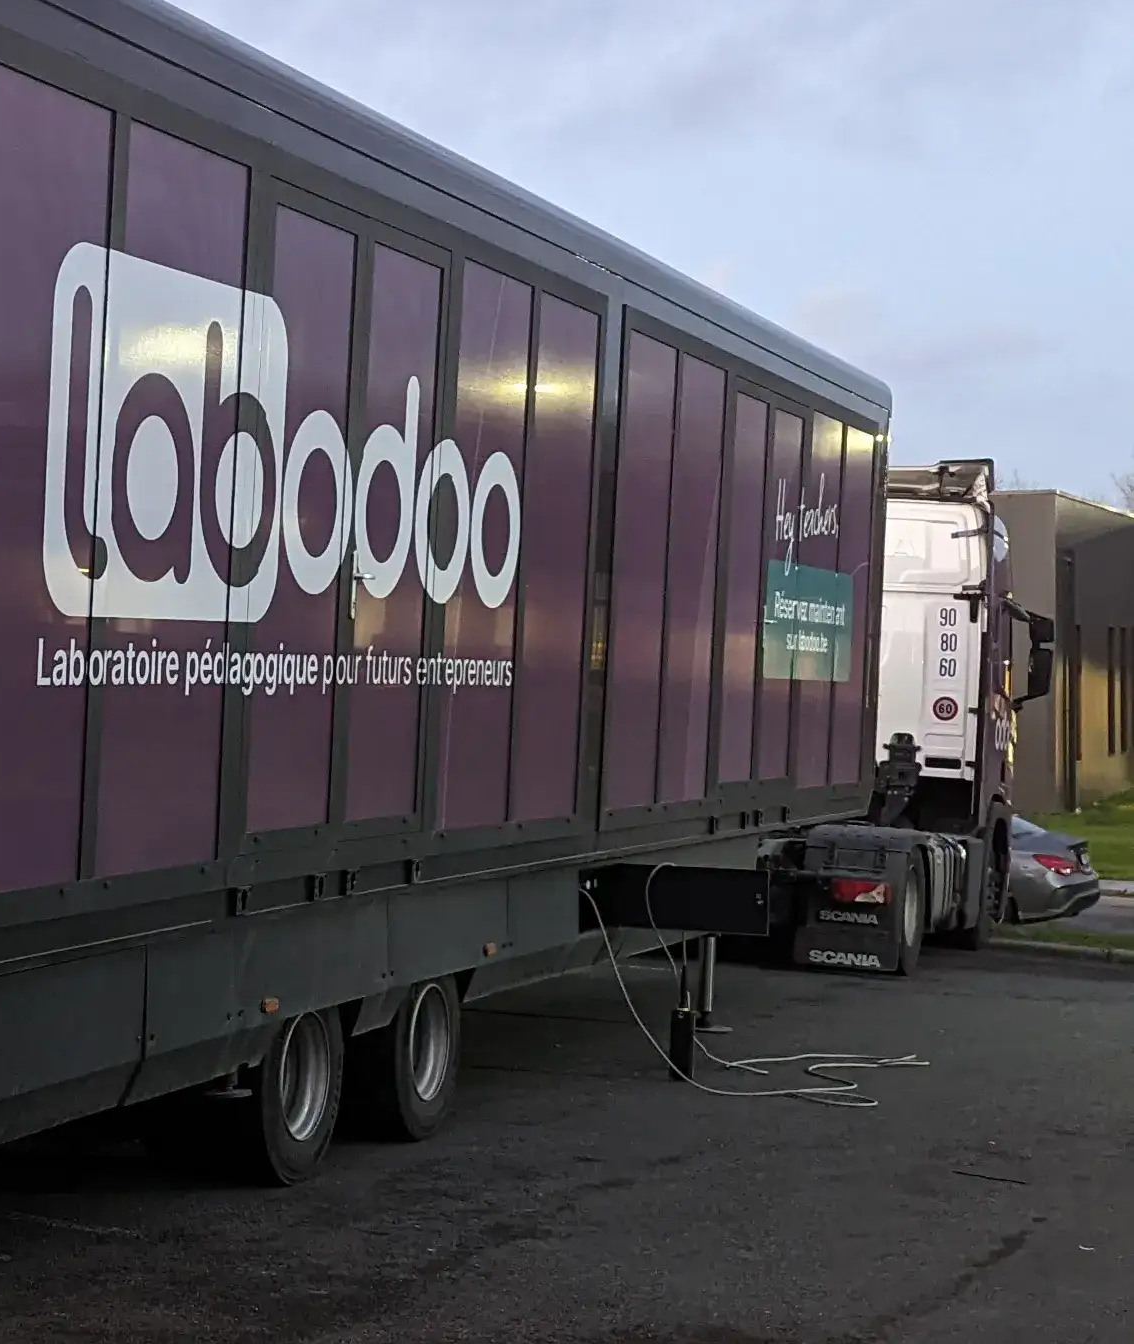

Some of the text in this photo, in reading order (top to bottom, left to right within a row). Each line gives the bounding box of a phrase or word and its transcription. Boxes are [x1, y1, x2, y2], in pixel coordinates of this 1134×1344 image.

[64, 284, 521, 610] labodoo
[775, 478, 795, 576] Hey
[939, 607, 957, 627] 90
[940, 633, 958, 652] 80
[36, 637, 514, 697] Laboratoire pédagogique pour futurs entrepreneurs
[939, 658, 957, 678] 60
[938, 702, 953, 715] 60
[818, 909, 879, 925] SCANIA
[808, 949, 881, 968] SCANIA
